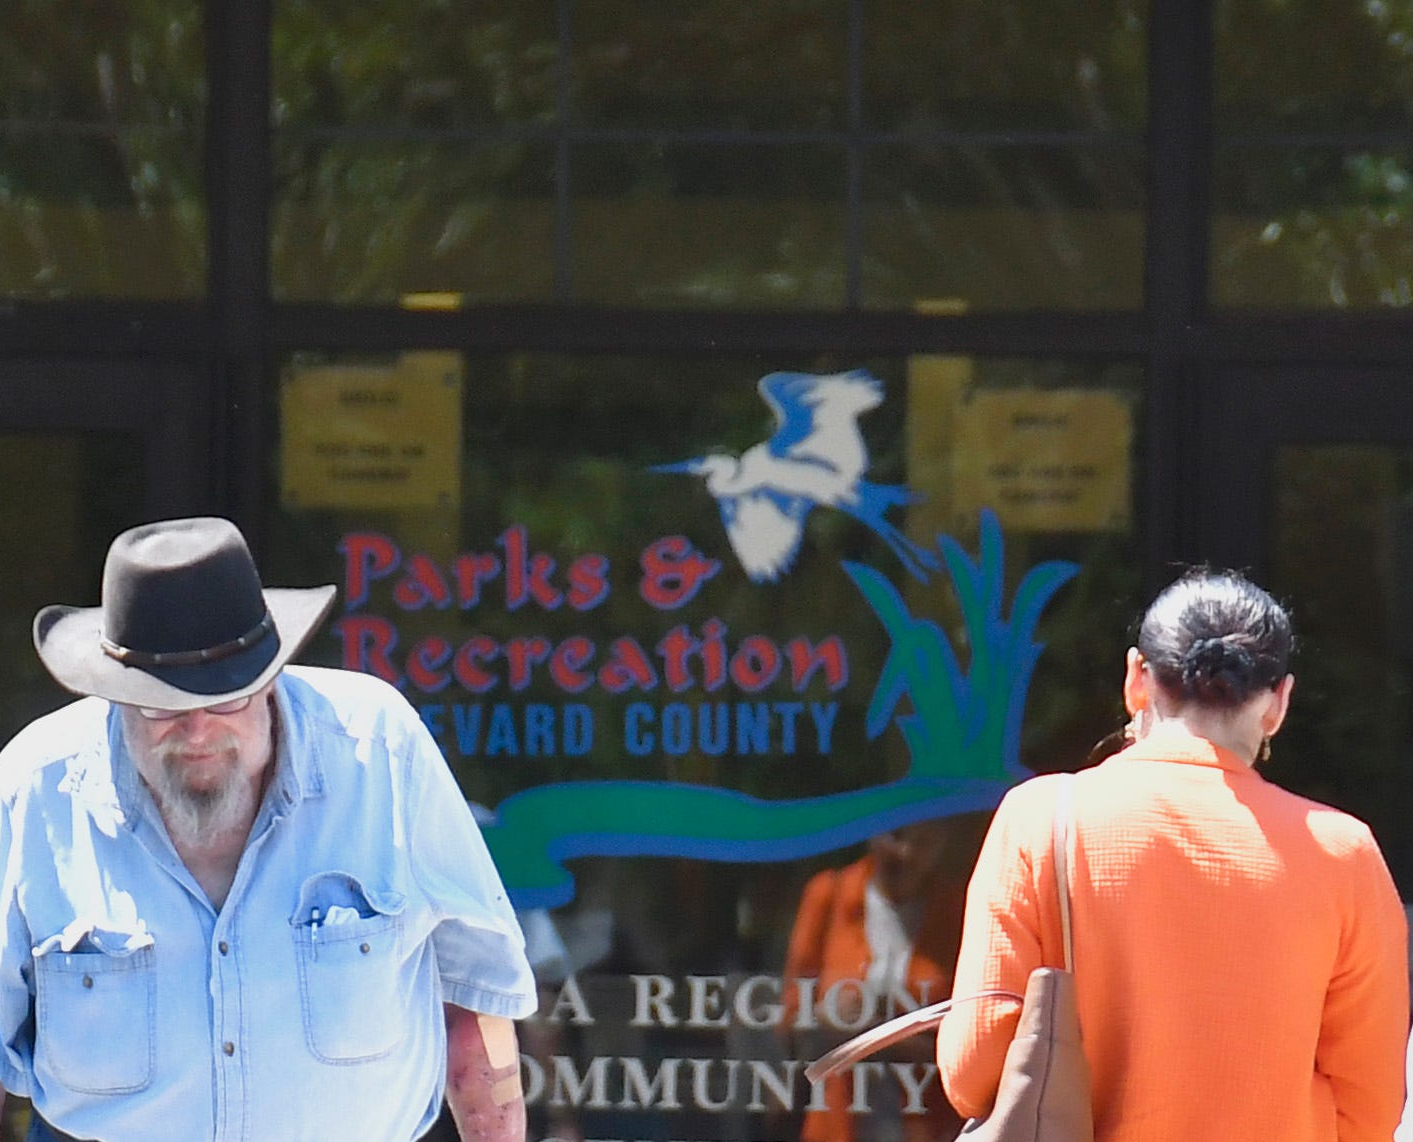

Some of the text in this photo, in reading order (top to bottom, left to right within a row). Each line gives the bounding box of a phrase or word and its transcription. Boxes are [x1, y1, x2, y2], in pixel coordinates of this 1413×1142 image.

[341, 526, 721, 611] Parks &
[333, 615, 849, 694] Recreation
[625, 702, 839, 756] COUNTY
